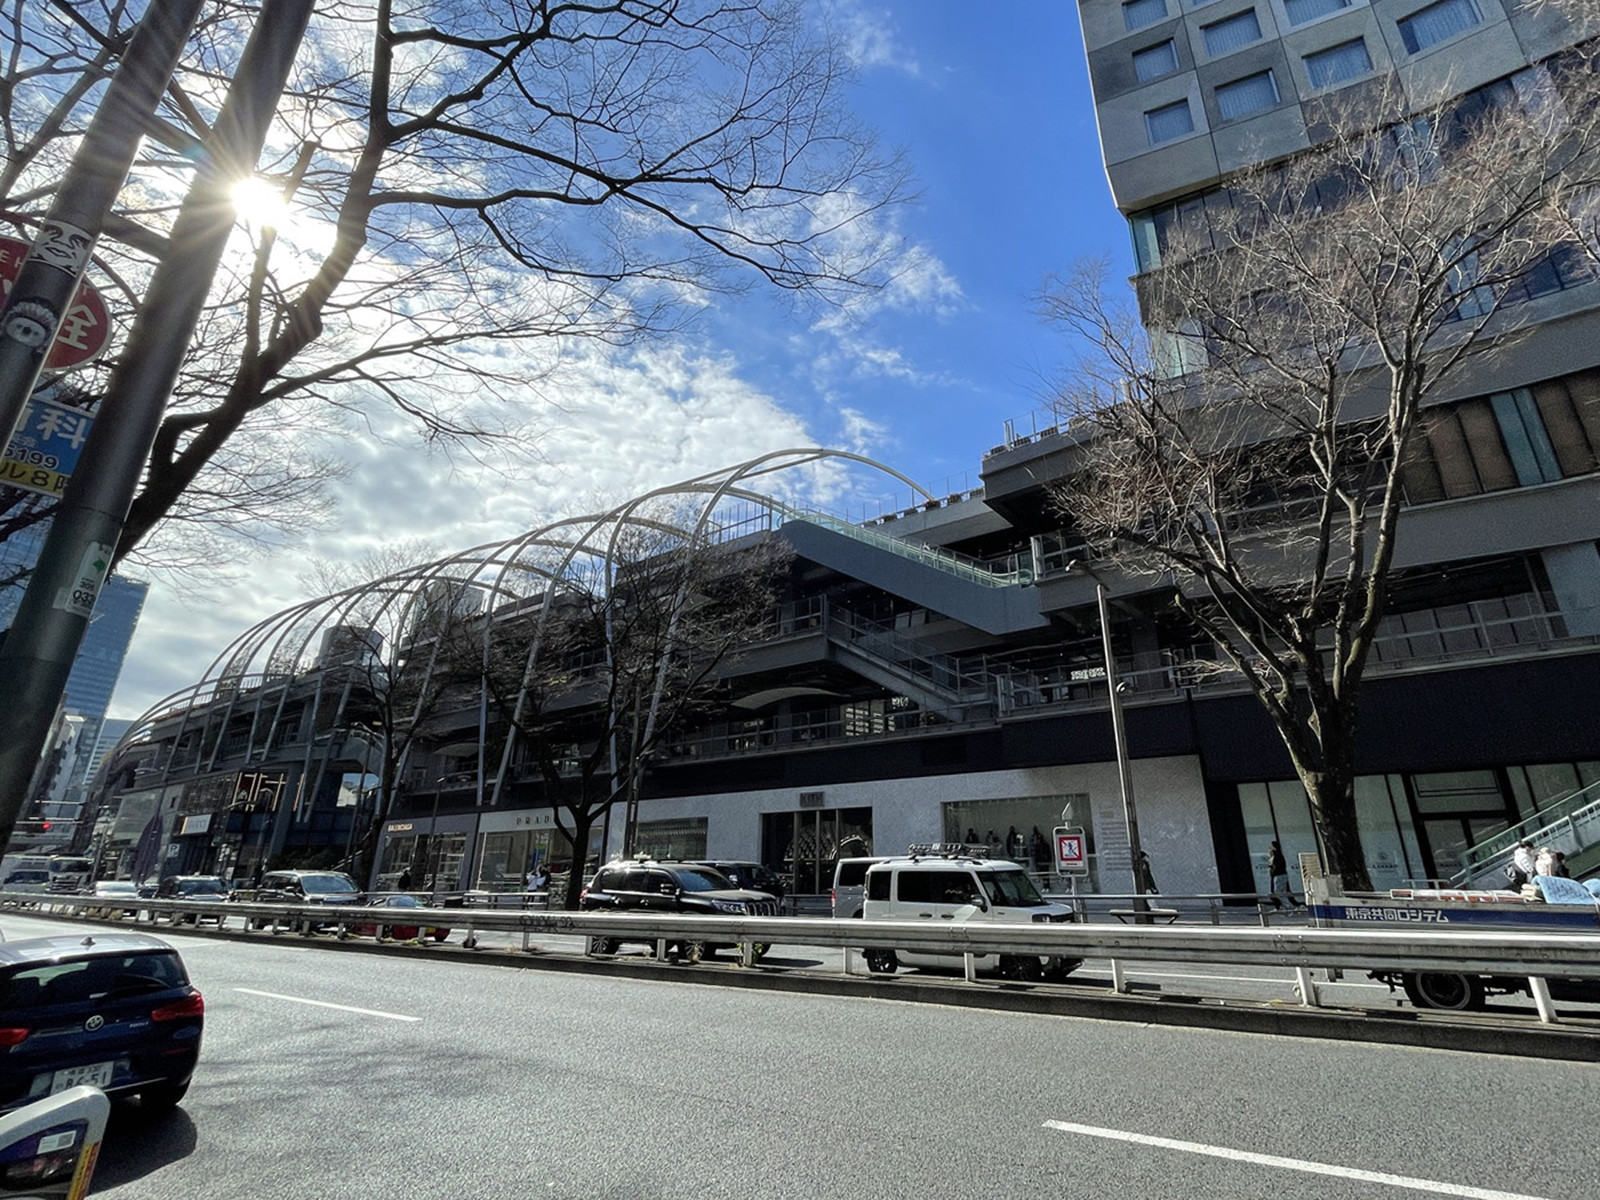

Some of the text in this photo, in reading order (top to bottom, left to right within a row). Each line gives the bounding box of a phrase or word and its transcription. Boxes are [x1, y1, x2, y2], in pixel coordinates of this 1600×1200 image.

[1345, 907, 1449, 923] 東京共同ロジテム
